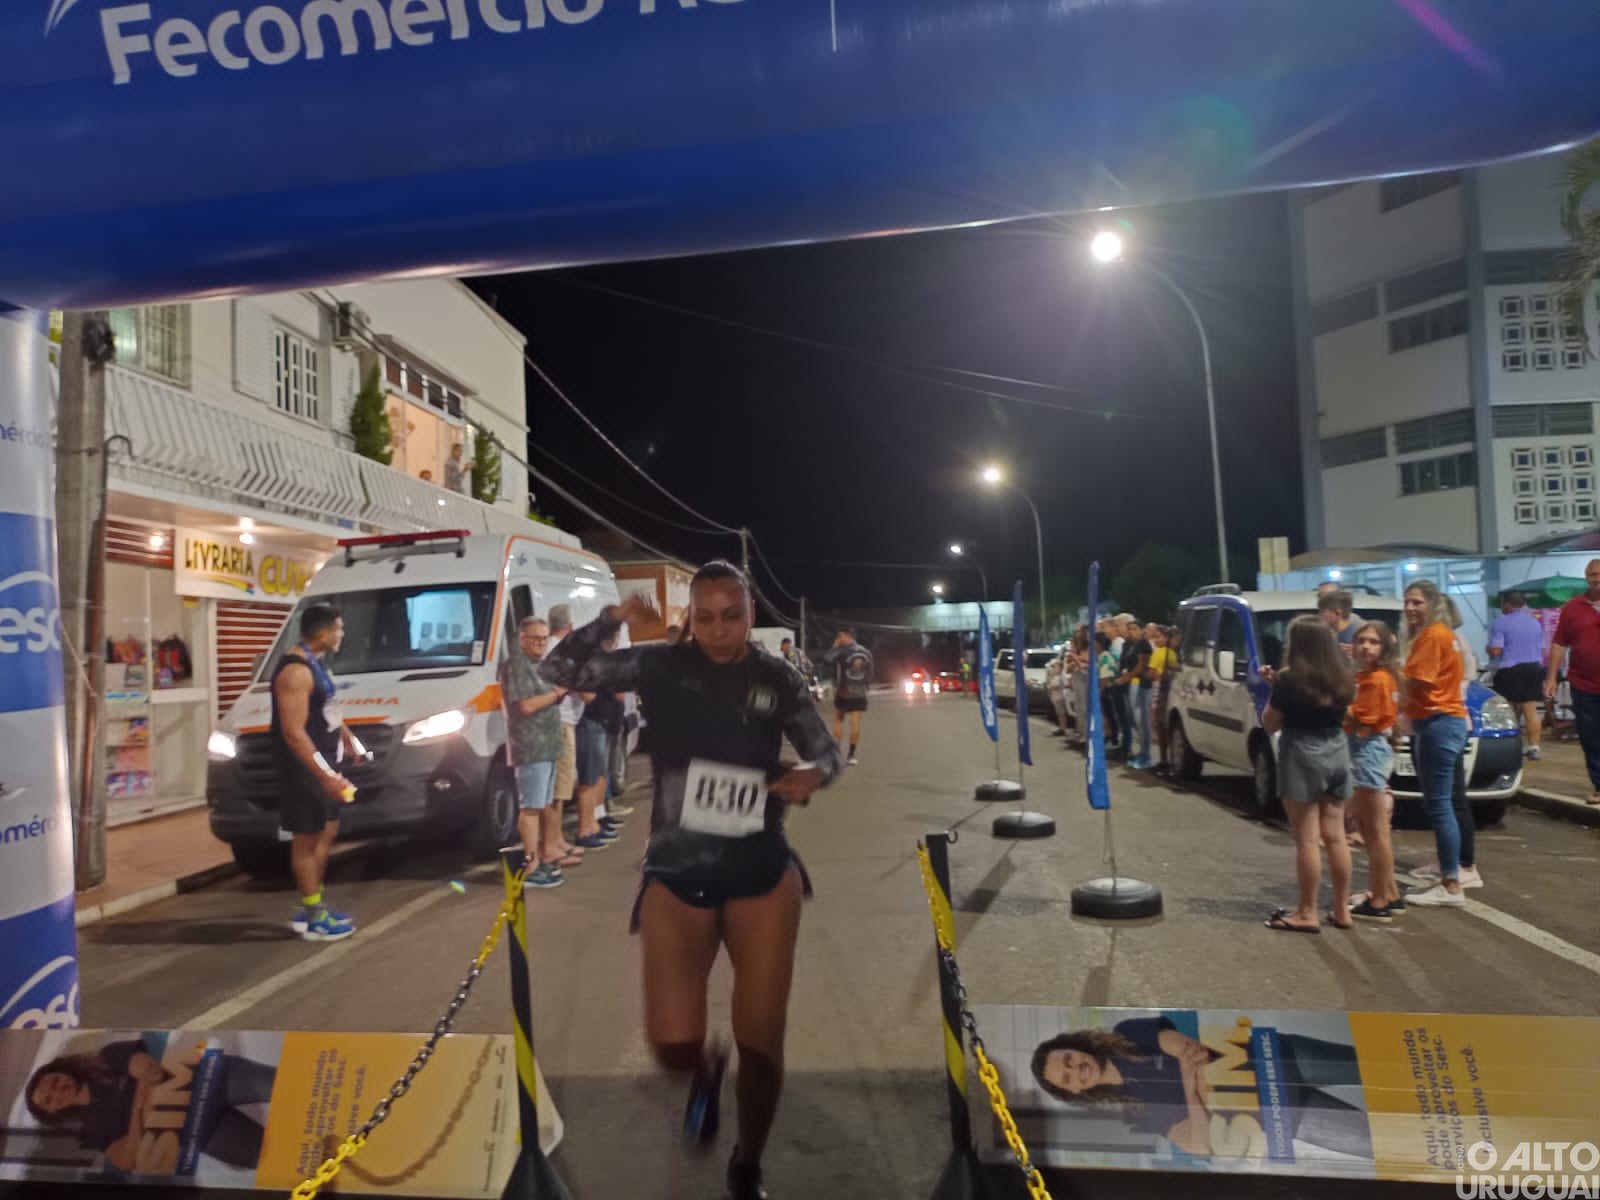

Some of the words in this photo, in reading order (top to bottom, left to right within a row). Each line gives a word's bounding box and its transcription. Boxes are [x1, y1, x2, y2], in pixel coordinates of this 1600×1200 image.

[185, 538, 255, 578] LIVRARIA
[1403, 1029, 1424, 1080] mundo
[1416, 1026, 1429, 1043] os
[1269, 1081, 1282, 1119] PODEM
[1416, 1084, 1431, 1121] todo
[1421, 1047, 1447, 1124] aproveitar
[1440, 1074, 1456, 1096] do
[1424, 1125, 1440, 1167] Aqui,
[1437, 1129, 1456, 1171] pode
